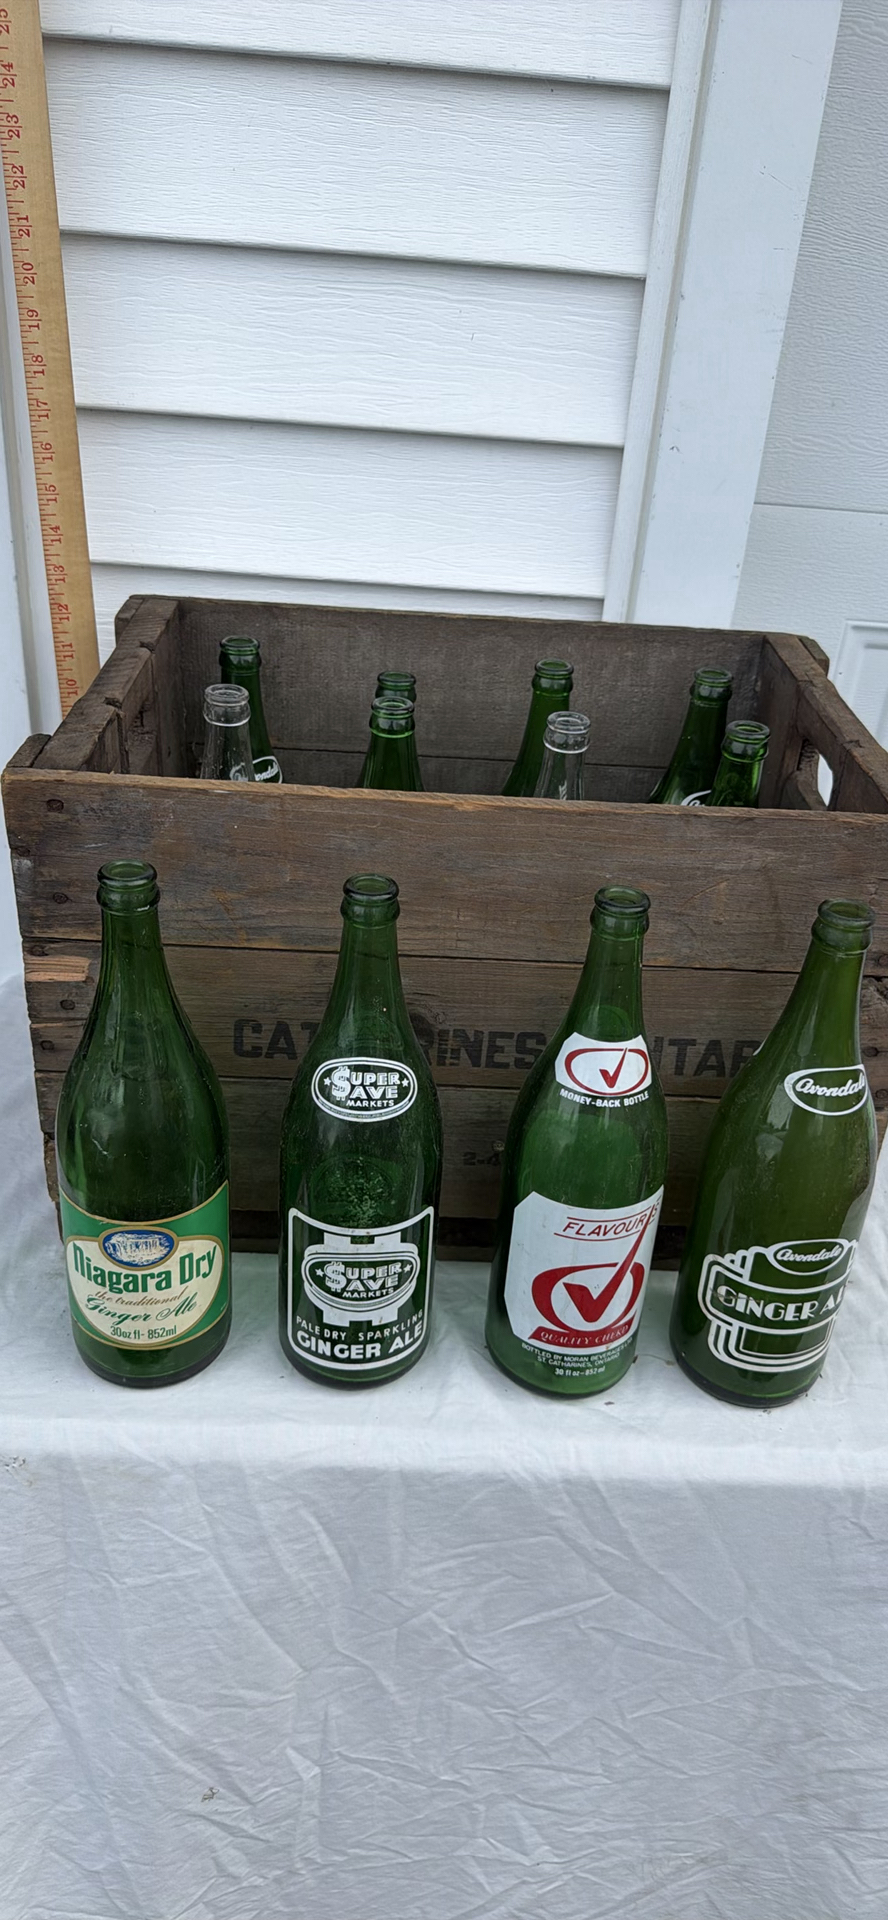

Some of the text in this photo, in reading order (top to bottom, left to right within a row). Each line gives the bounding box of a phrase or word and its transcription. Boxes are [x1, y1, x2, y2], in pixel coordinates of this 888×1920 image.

[346, 1100, 394, 1108] MARKETS
[560, 1088, 649, 1108] MONEY-BACK BOTTLE
[775, 1244, 842, 1262] Avondale
[73, 1242, 218, 1294] Niagara Dry
[94, 1286, 189, 1306] the traditional
[342, 1288, 394, 1298] MARKETS
[85, 1292, 198, 1326] Ginger Ale
[717, 1285, 818, 1321] GINGER
[147, 1325, 177, 1340] 852ml
[296, 1309, 423, 1341] PALE DRY SPARKLING
[296, 1320, 423, 1359] GINGER ALE
[540, 1331, 592, 1344] QUALITY
[521, 1342, 552, 1359] BOTTLED
[590, 1344, 625, 1360] BEVERAGES
[594, 1352, 621, 1366] ONTARIO
[555, 1368, 564, 1376] 30
